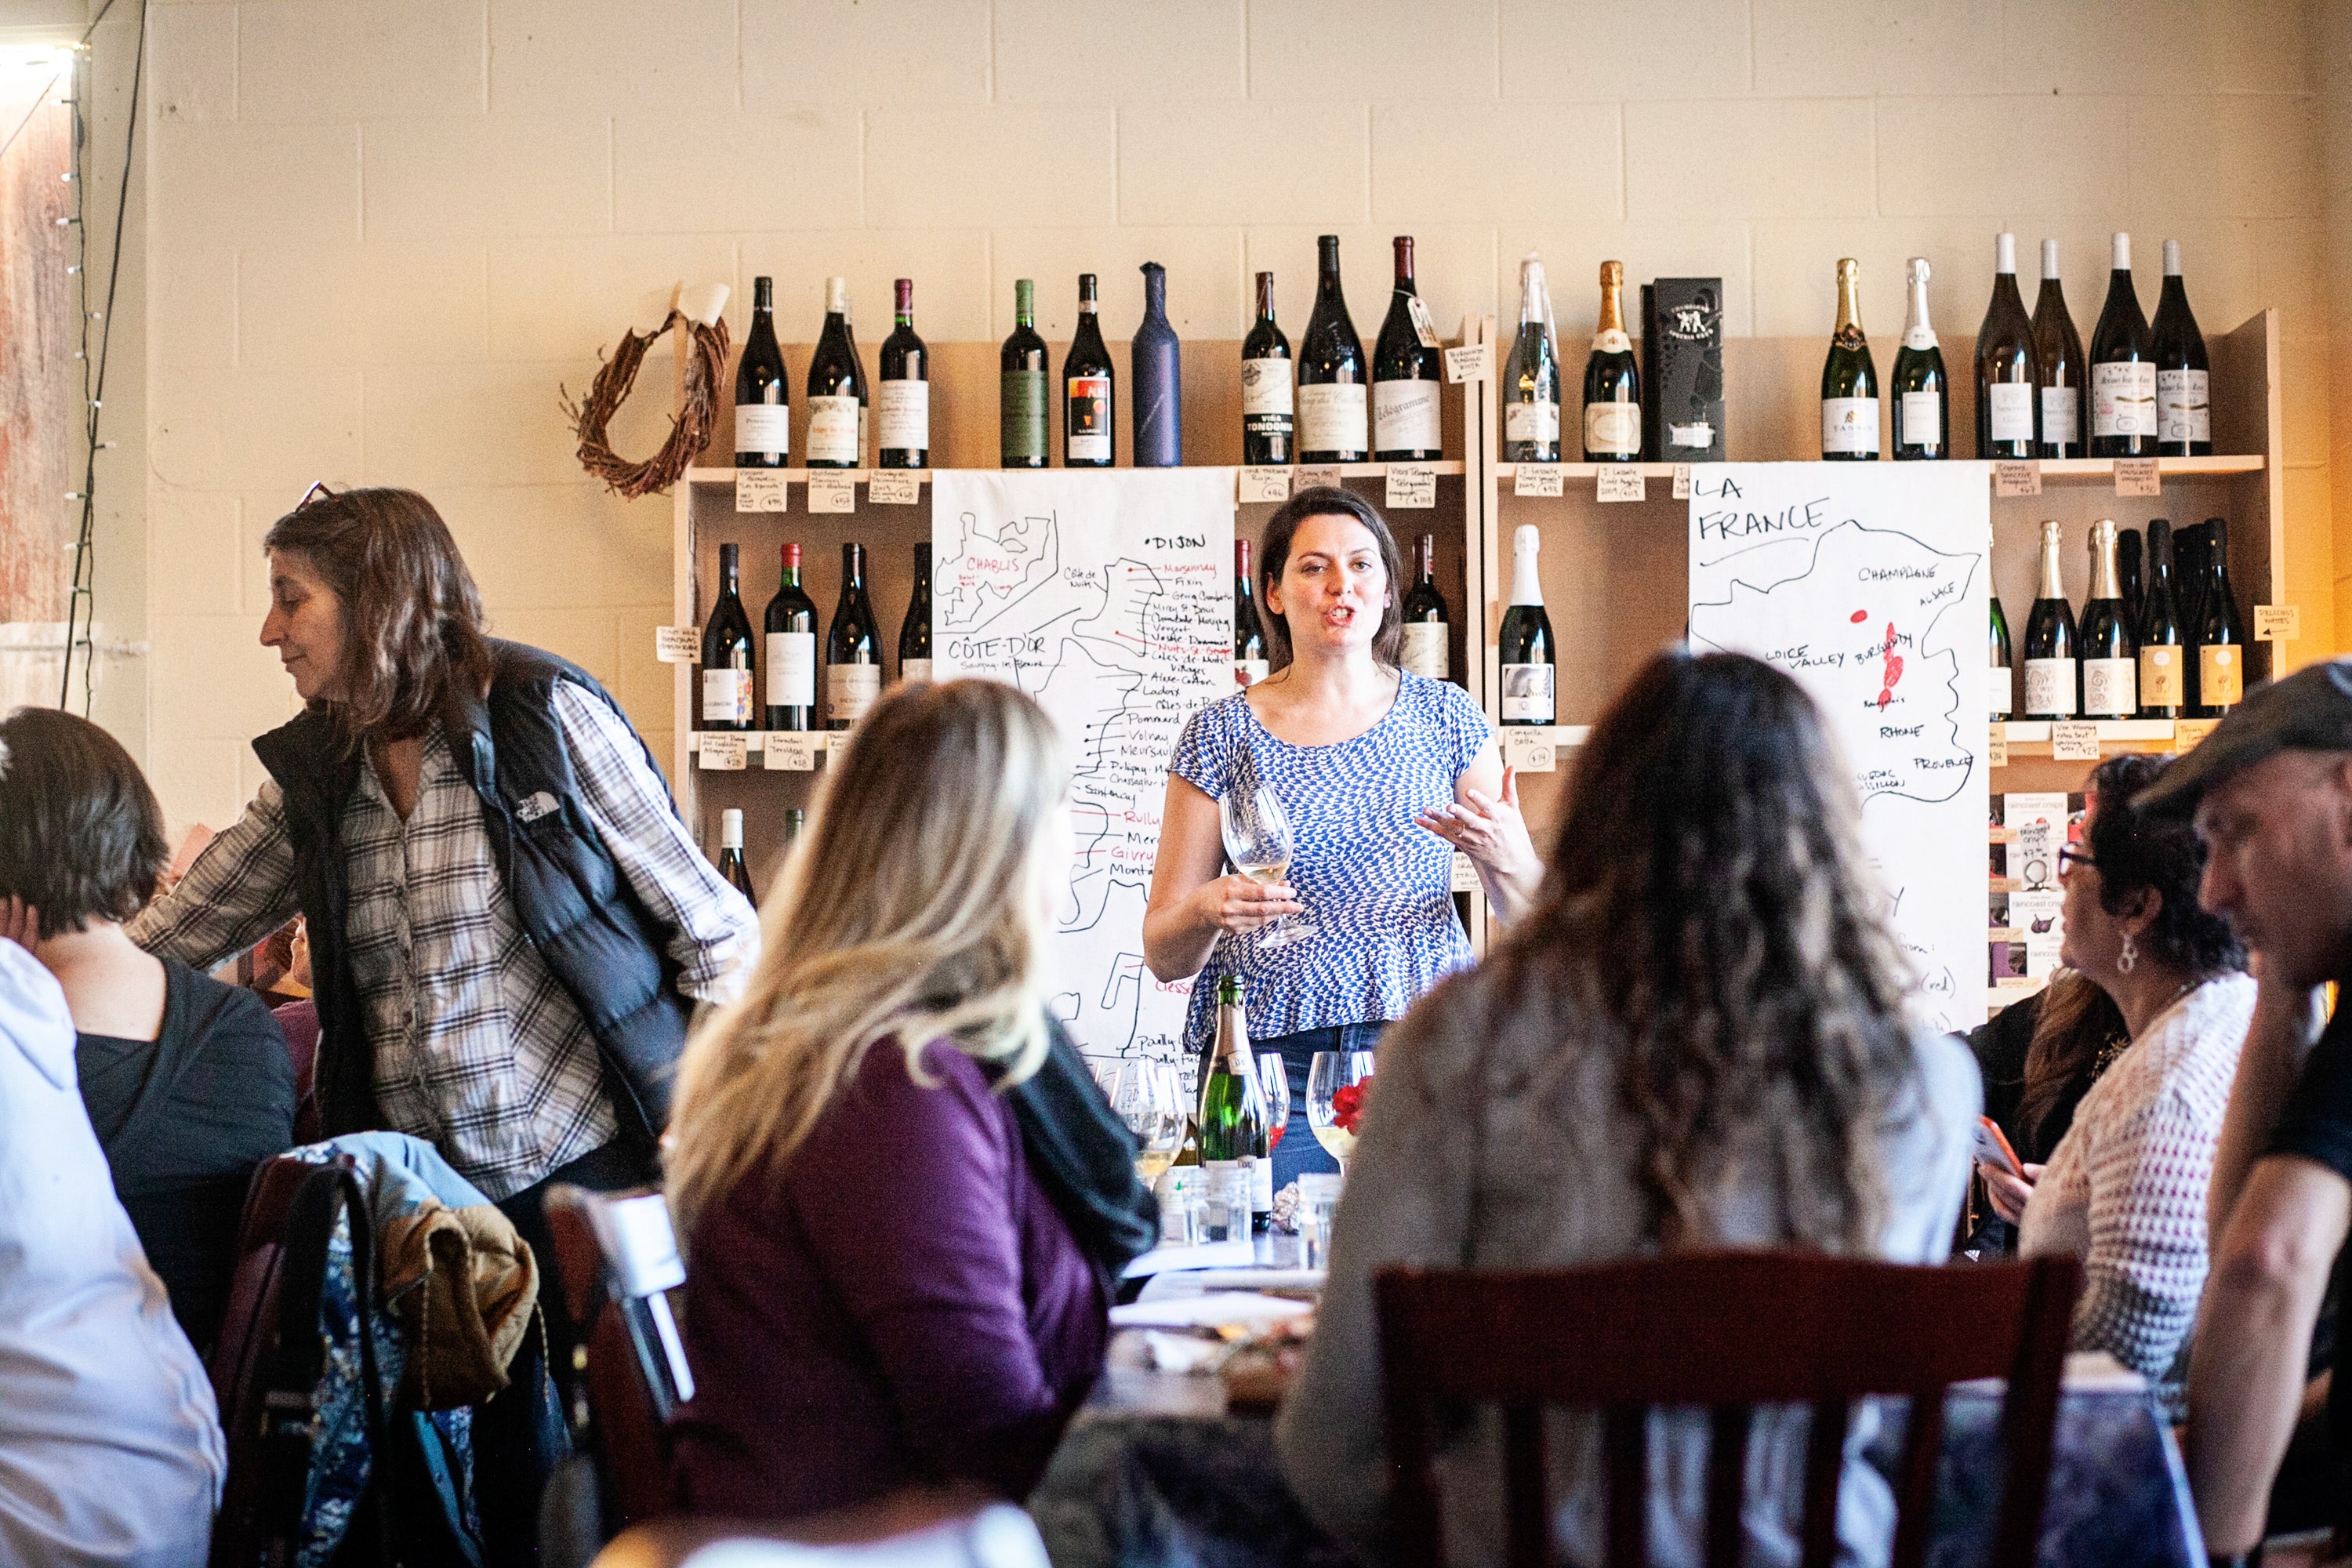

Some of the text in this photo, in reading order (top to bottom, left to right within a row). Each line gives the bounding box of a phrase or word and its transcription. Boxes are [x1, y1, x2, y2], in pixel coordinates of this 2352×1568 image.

[1694, 477, 1743, 499] LA
[1698, 496, 1831, 540] FRANCE
[1154, 534, 1206, 549] DIJON
[966, 557, 1020, 573] CHABLIS
[1858, 563, 1940, 582] CHAMPAGNE
[1175, 576, 1203, 586] Fixin
[1919, 581, 1955, 607] ALSACE
[1765, 644, 1809, 662] LOIRE
[1854, 633, 1913, 666] BURGUNDY
[1788, 652, 1846, 670] VALLEY
[1127, 712, 1183, 726] Pommard
[1128, 729, 1169, 746] Volnay
[1880, 724, 1926, 739] RHONE
[1913, 755, 1975, 770] PROVENCE
[1123, 811, 1162, 831] Rully
[1110, 845, 1154, 867] Givry
[1921, 965, 1956, 1000] (red)
